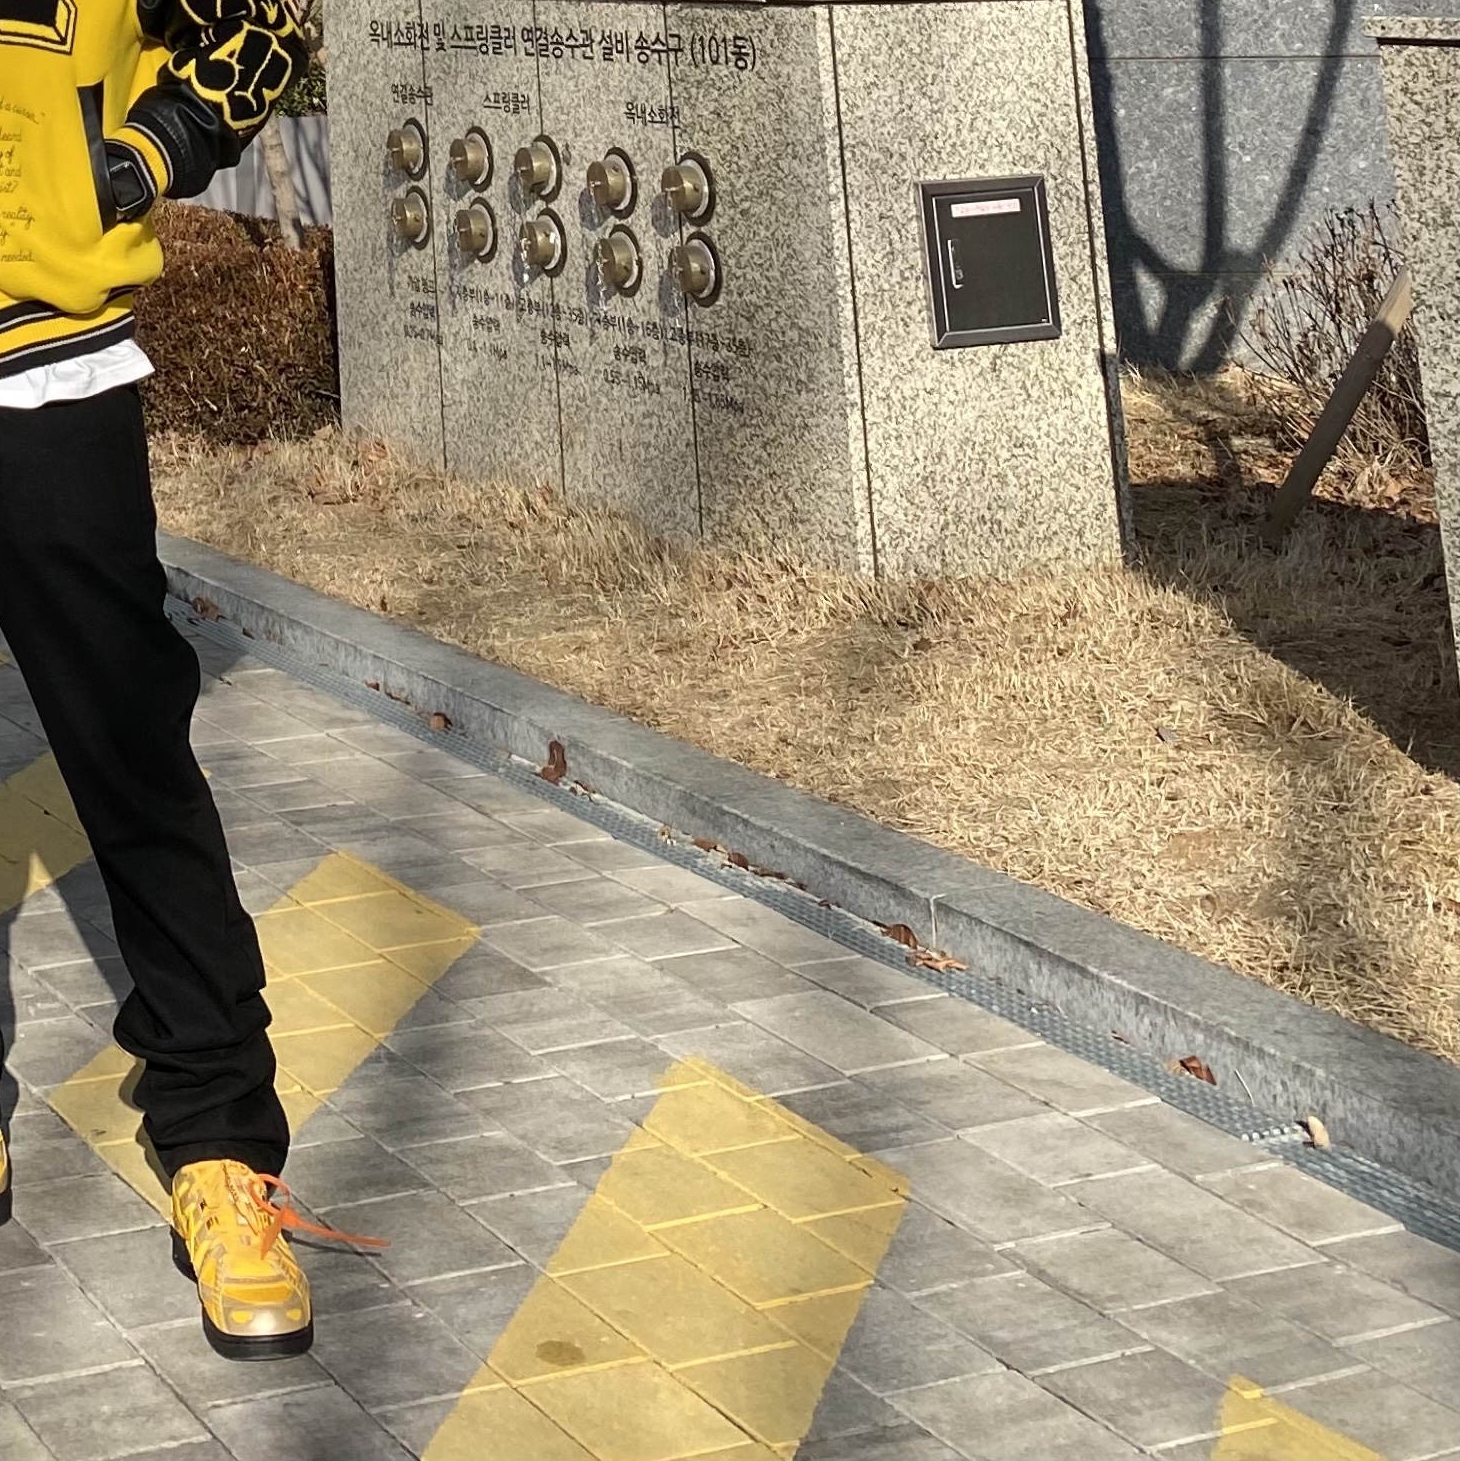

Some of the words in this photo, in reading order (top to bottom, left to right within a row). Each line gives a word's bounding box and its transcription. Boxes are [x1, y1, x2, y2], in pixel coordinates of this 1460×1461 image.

[368, 20, 430, 51] 옥내소화전
[433, 20, 447, 52] 및
[450, 24, 518, 57] 스프링클러
[521, 25, 595, 61] 연결송수관
[598, 29, 630, 63] 설비
[634, 31, 684, 67] 송수구
[690, 33, 757, 72] (101동)
[391, 83, 434, 106] 연결송수관
[483, 92, 531, 115] 스프링클러
[623, 102, 681, 131] 옥내소화전
[4, 145, 15, 165] of
[4, 161, 22, 178] and
